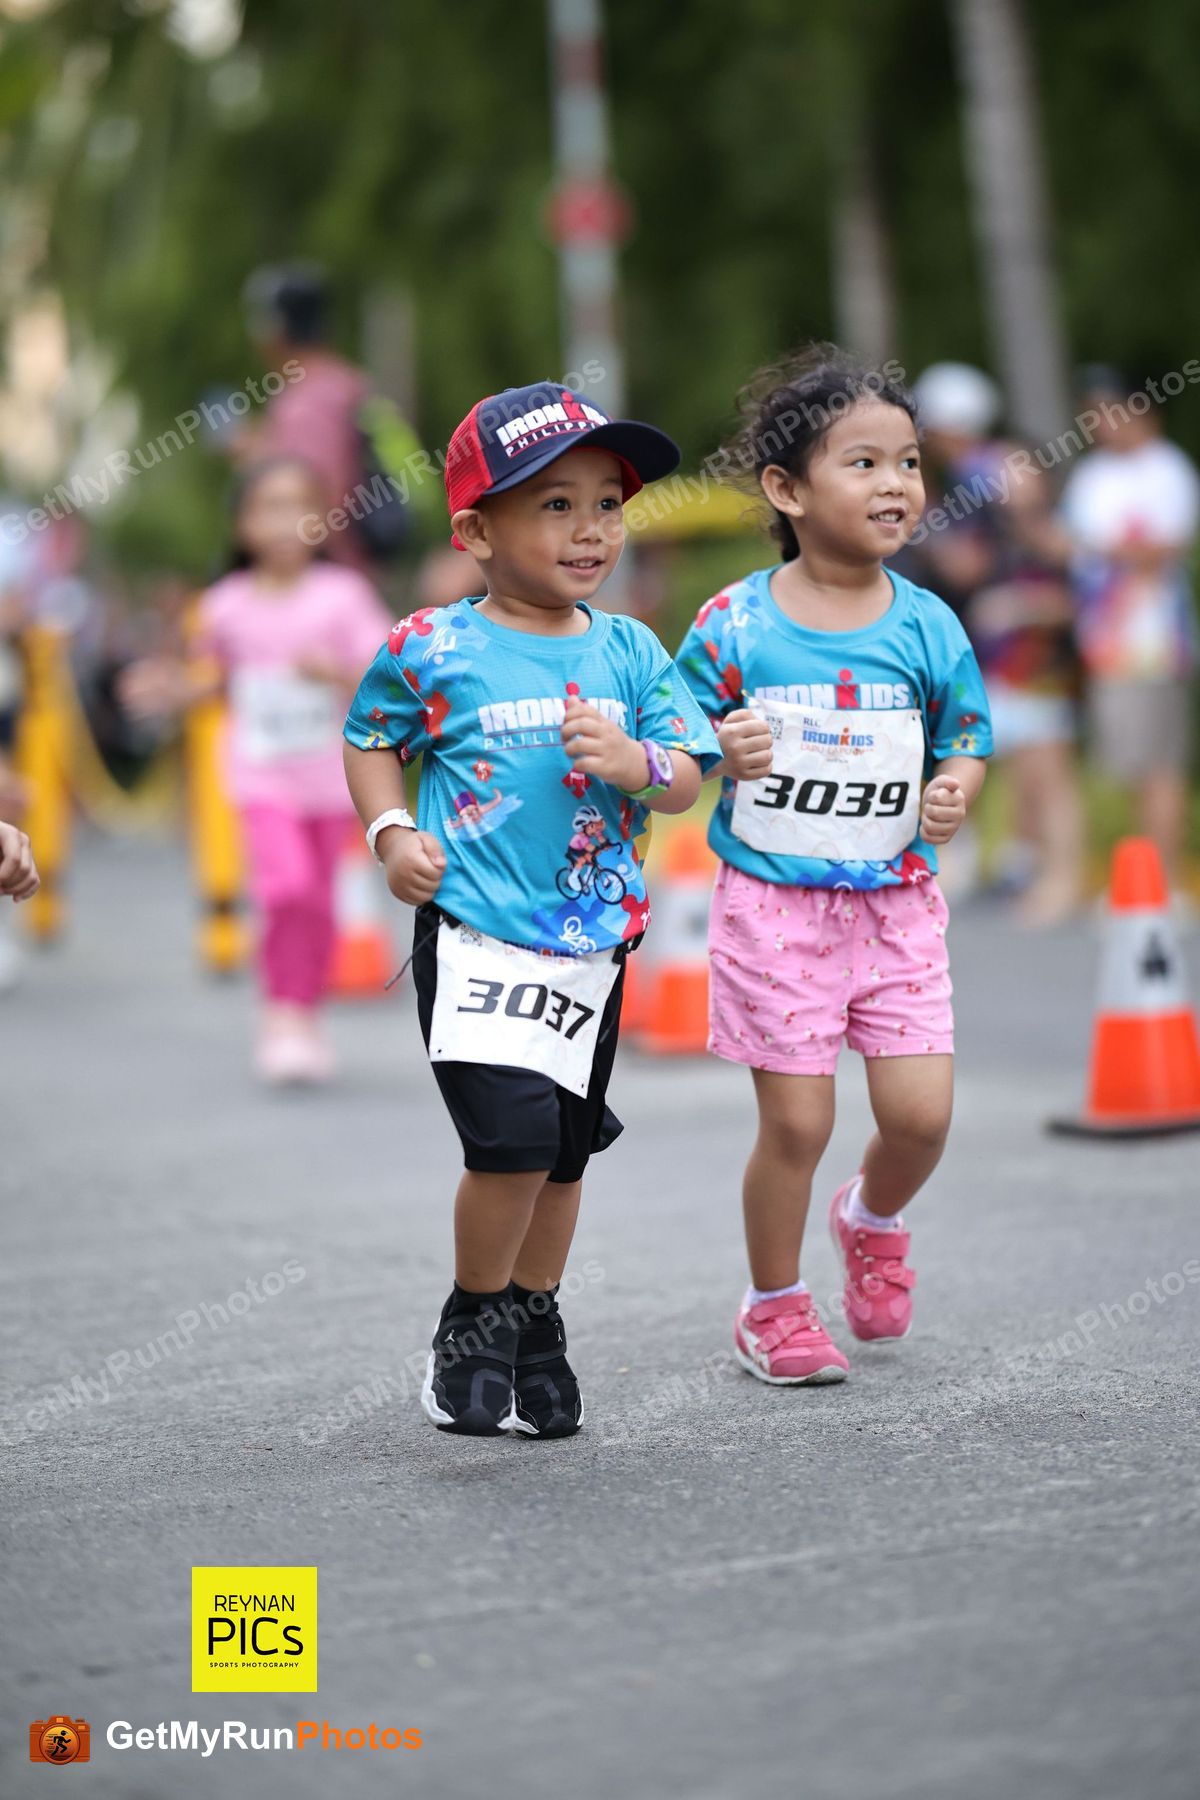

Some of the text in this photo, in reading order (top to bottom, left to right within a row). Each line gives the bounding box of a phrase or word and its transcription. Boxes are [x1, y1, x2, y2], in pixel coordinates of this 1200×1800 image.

[505, 421, 596, 457] PHILIPPI
[478, 682, 629, 734] IRONDS
[802, 727, 874, 746] IRONKIDS
[754, 773, 909, 817] 3039
[457, 978, 595, 1040] 3037
